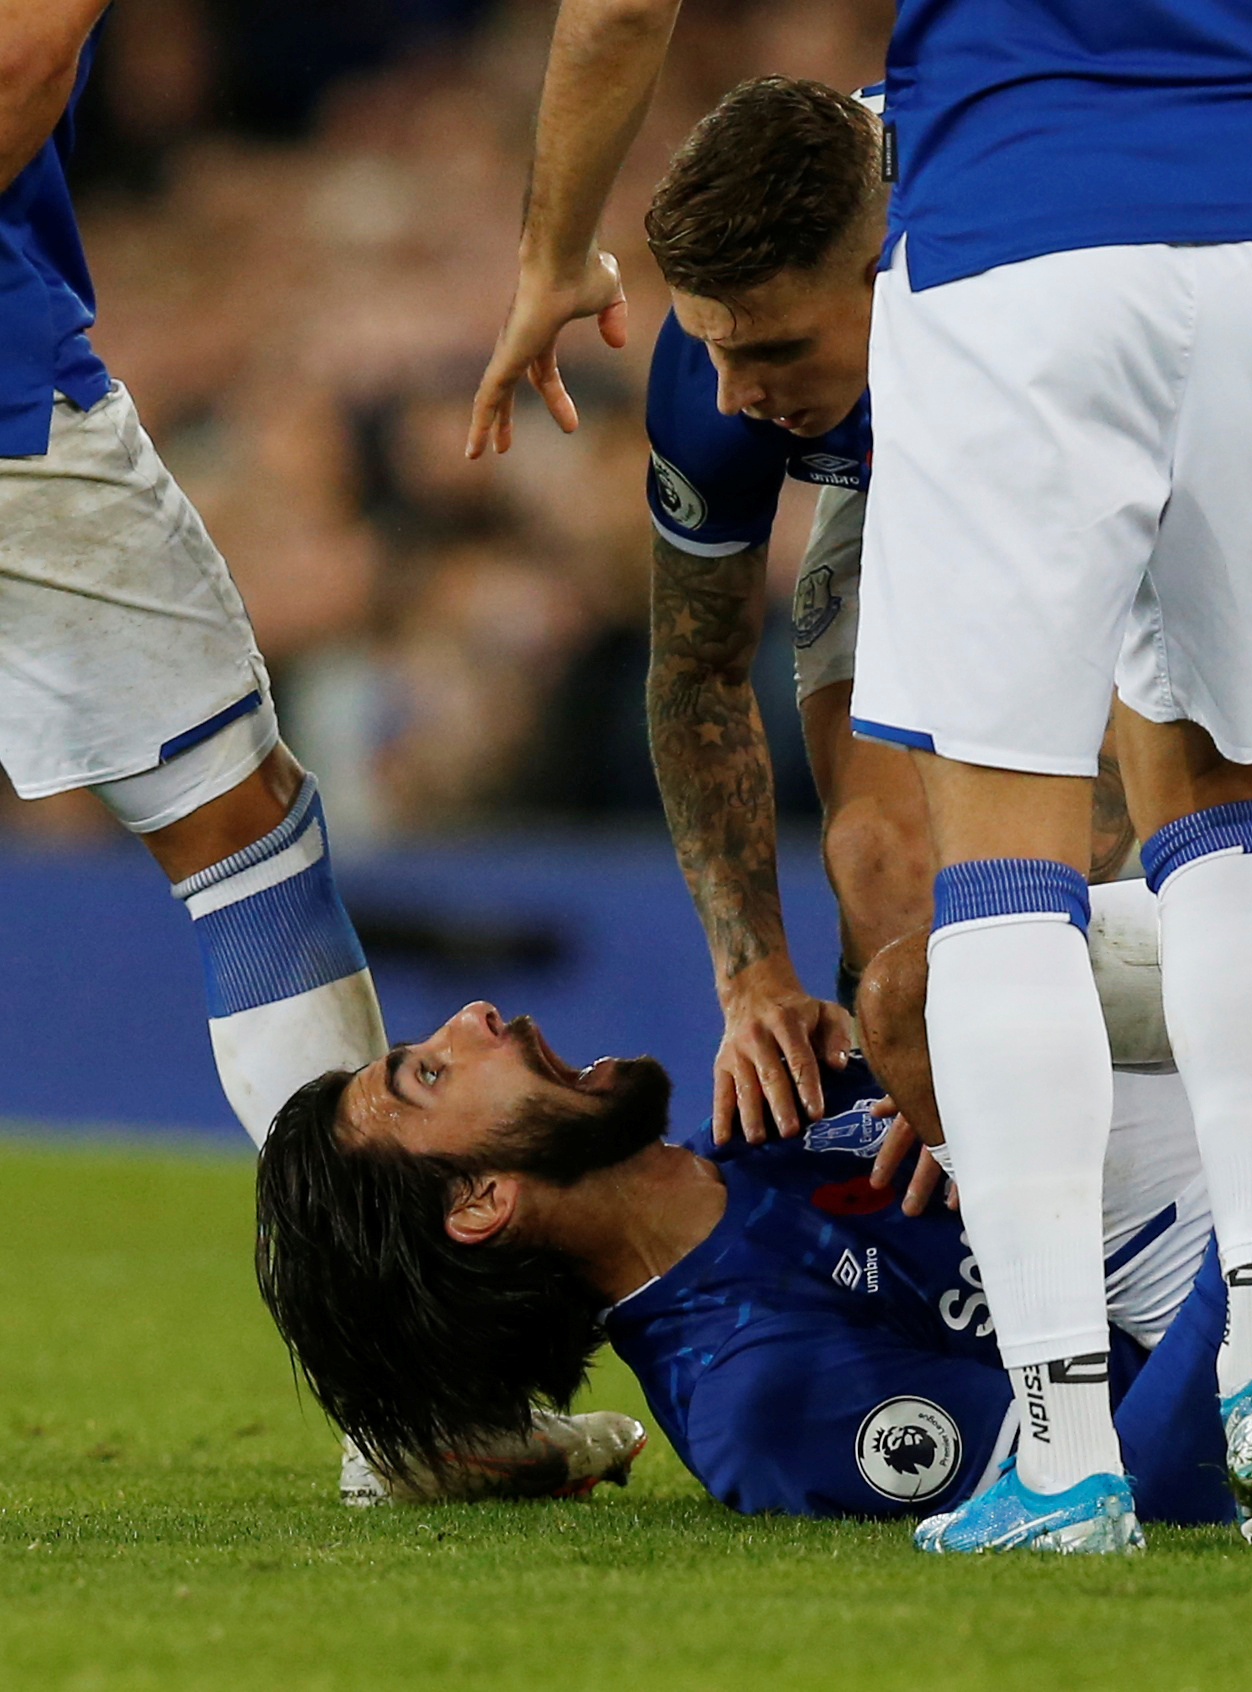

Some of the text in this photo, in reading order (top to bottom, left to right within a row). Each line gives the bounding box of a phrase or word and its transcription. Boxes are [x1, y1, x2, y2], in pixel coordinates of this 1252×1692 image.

[810, 472, 860, 485] umbro
[866, 1247, 878, 1292] umbro
[918, 1412, 951, 1468] Premier League
